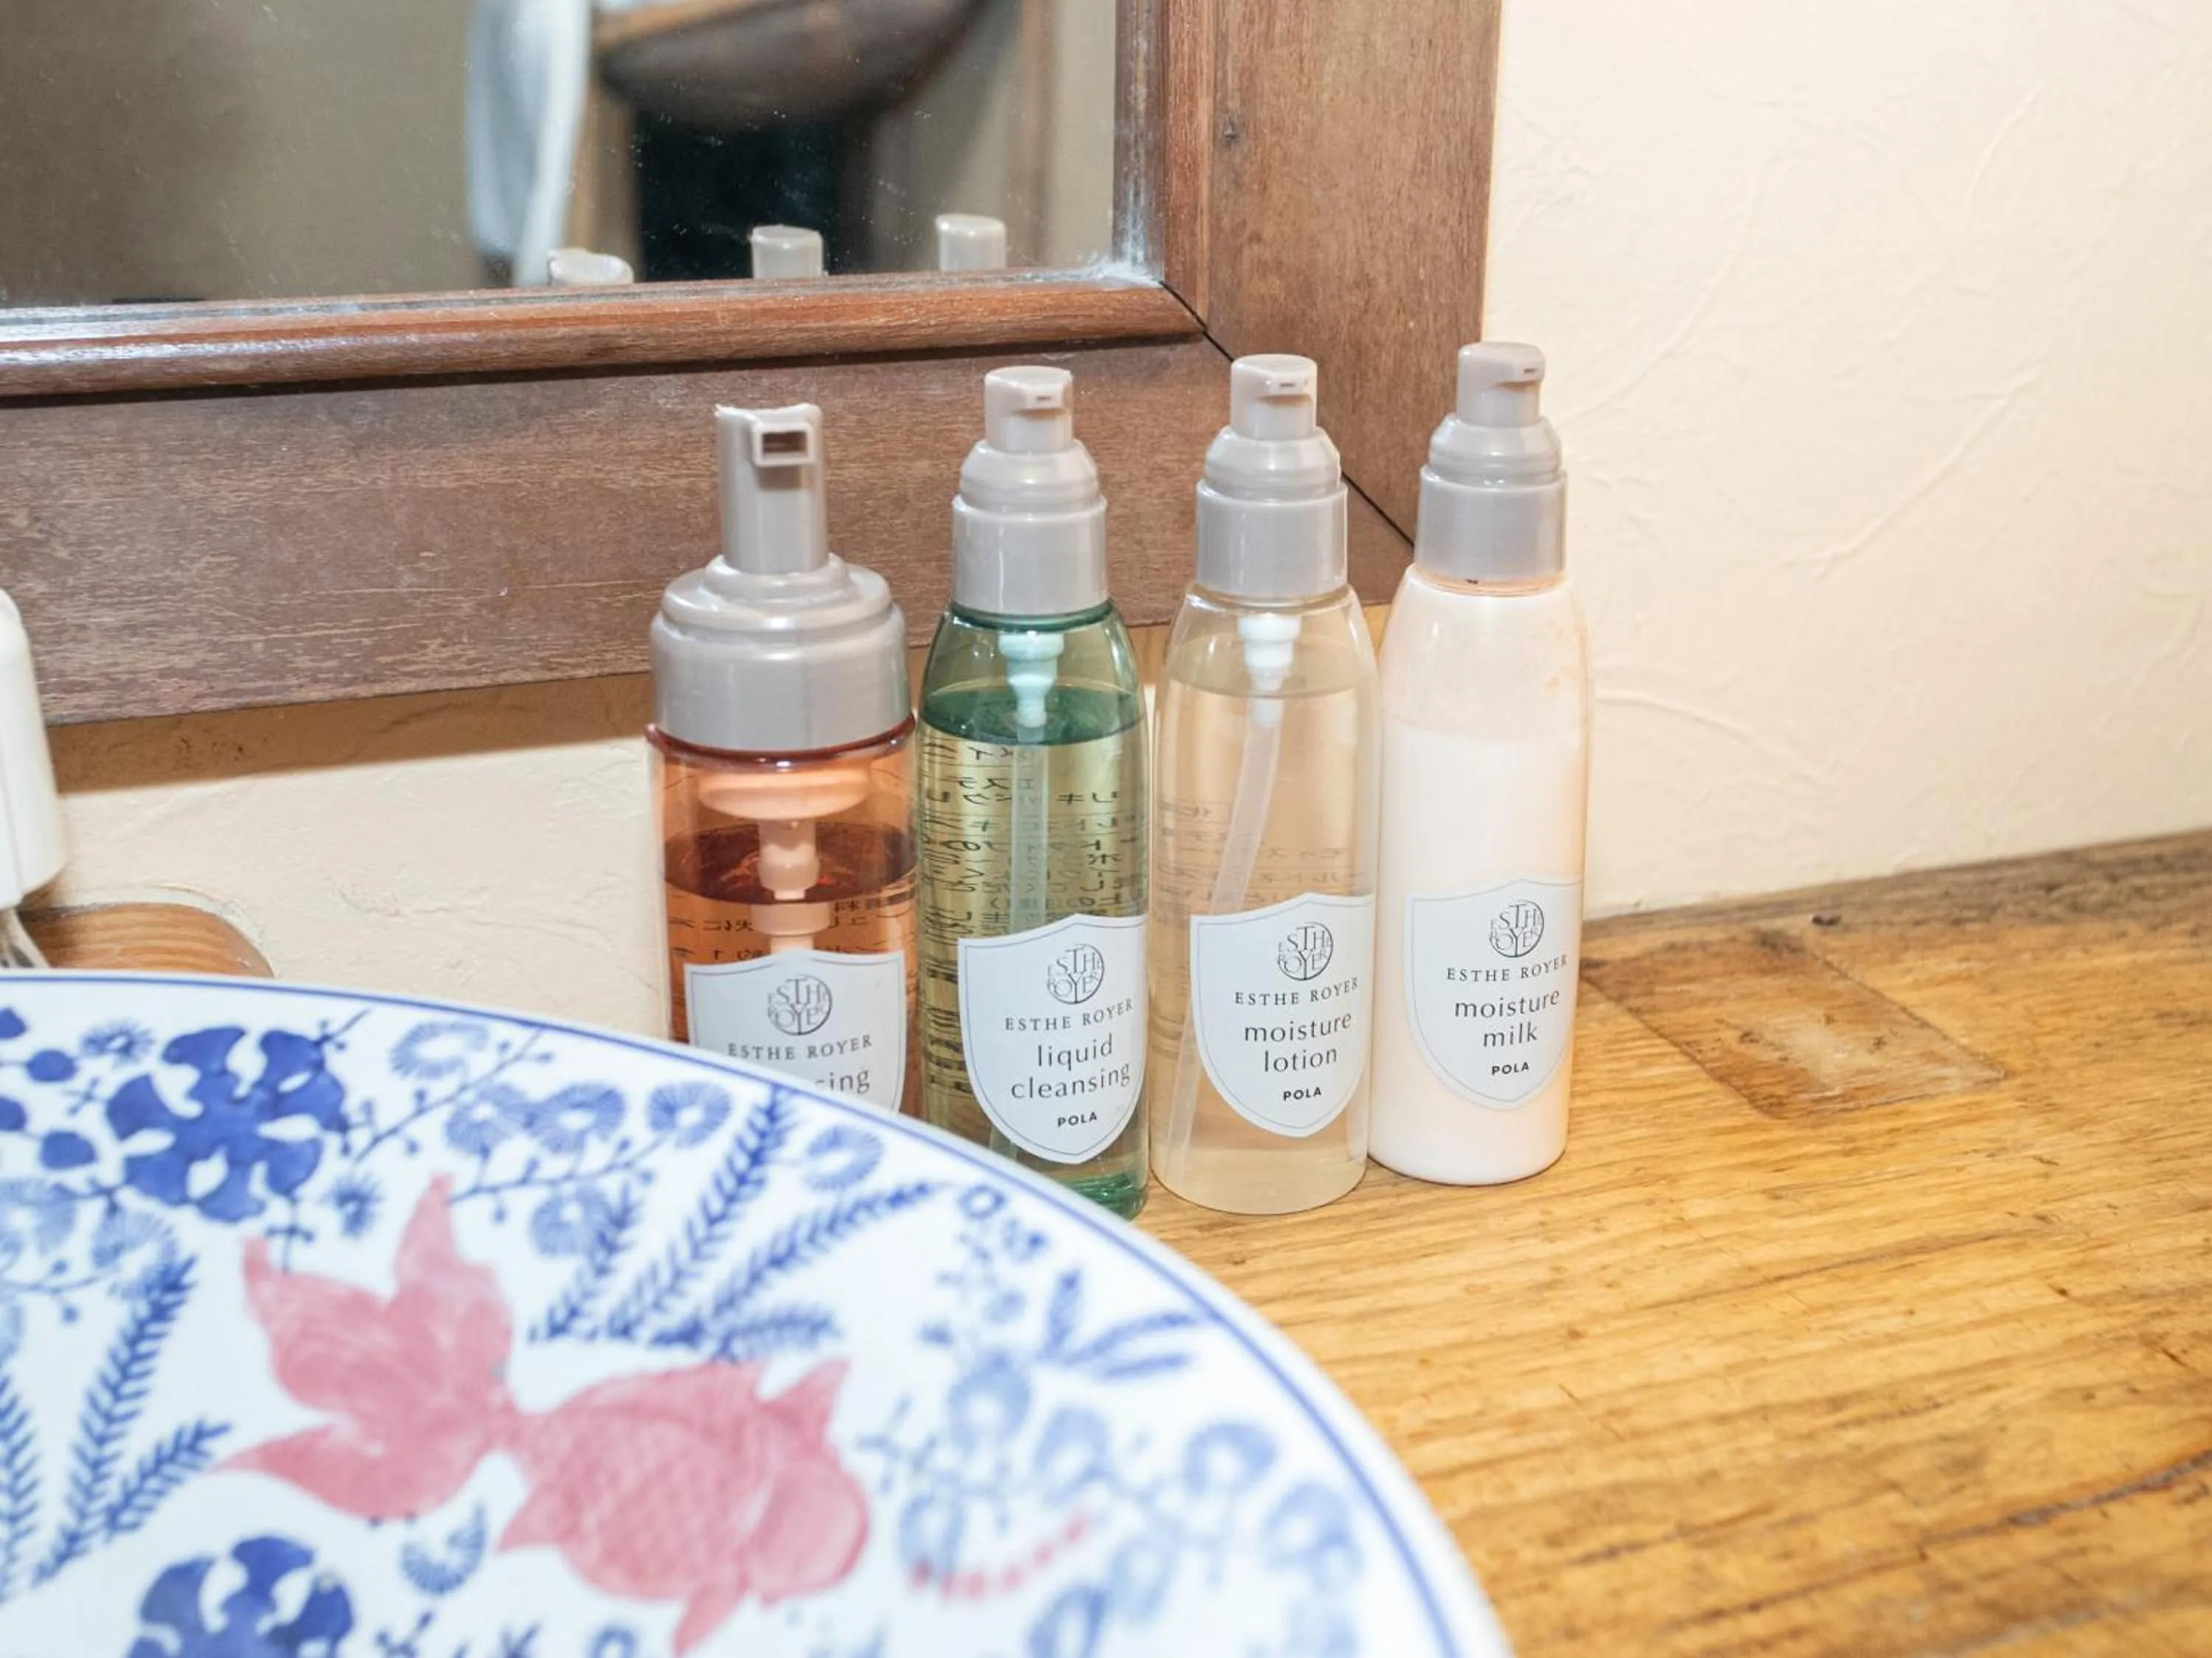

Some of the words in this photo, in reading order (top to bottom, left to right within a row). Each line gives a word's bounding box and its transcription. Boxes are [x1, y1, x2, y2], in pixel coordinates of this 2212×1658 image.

[1447, 967, 1510, 982] ESTHE
[1520, 954, 1568, 979] ROYER
[1234, 991, 1299, 1006] ESTHE
[1310, 977, 1358, 1002] ROYER
[1455, 990, 1559, 1019] moisture
[1005, 1016, 1071, 1032] ESTHE
[1082, 998, 1133, 1027] ROYER
[1244, 1012, 1352, 1042] moisture
[727, 1042, 796, 1061] ESTHE
[807, 1034, 872, 1059] ROYER
[1484, 1021, 1538, 1047] milk
[1037, 1032, 1113, 1071] liquid
[1264, 1047, 1338, 1072] lotion
[1010, 1064, 1130, 1100] cleansing
[1491, 1061, 1530, 1076] POLA
[1283, 1086, 1322, 1101] POLA
[1057, 1111, 1098, 1128] POLA
